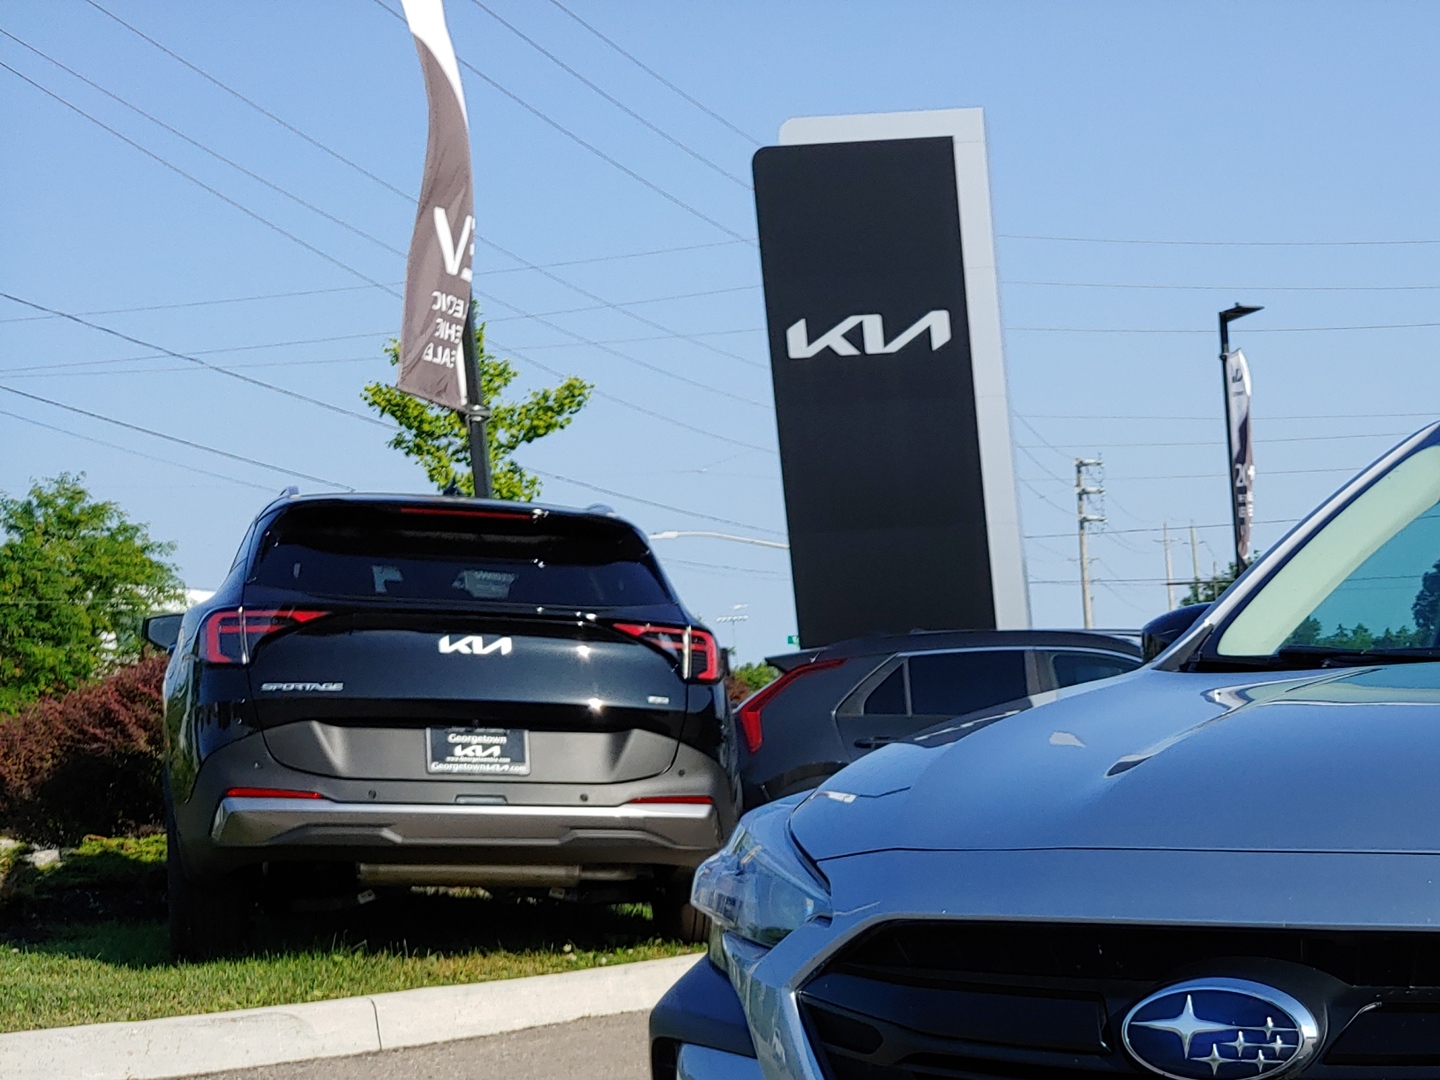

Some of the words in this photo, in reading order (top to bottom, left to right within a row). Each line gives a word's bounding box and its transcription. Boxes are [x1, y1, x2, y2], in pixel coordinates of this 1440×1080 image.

[786, 309, 951, 360] KIA
[438, 635, 512, 655] KIA
[261, 682, 344, 692] SPORTAGE
[447, 733, 507, 744] Georgetown
[453, 744, 501, 757] KIA
